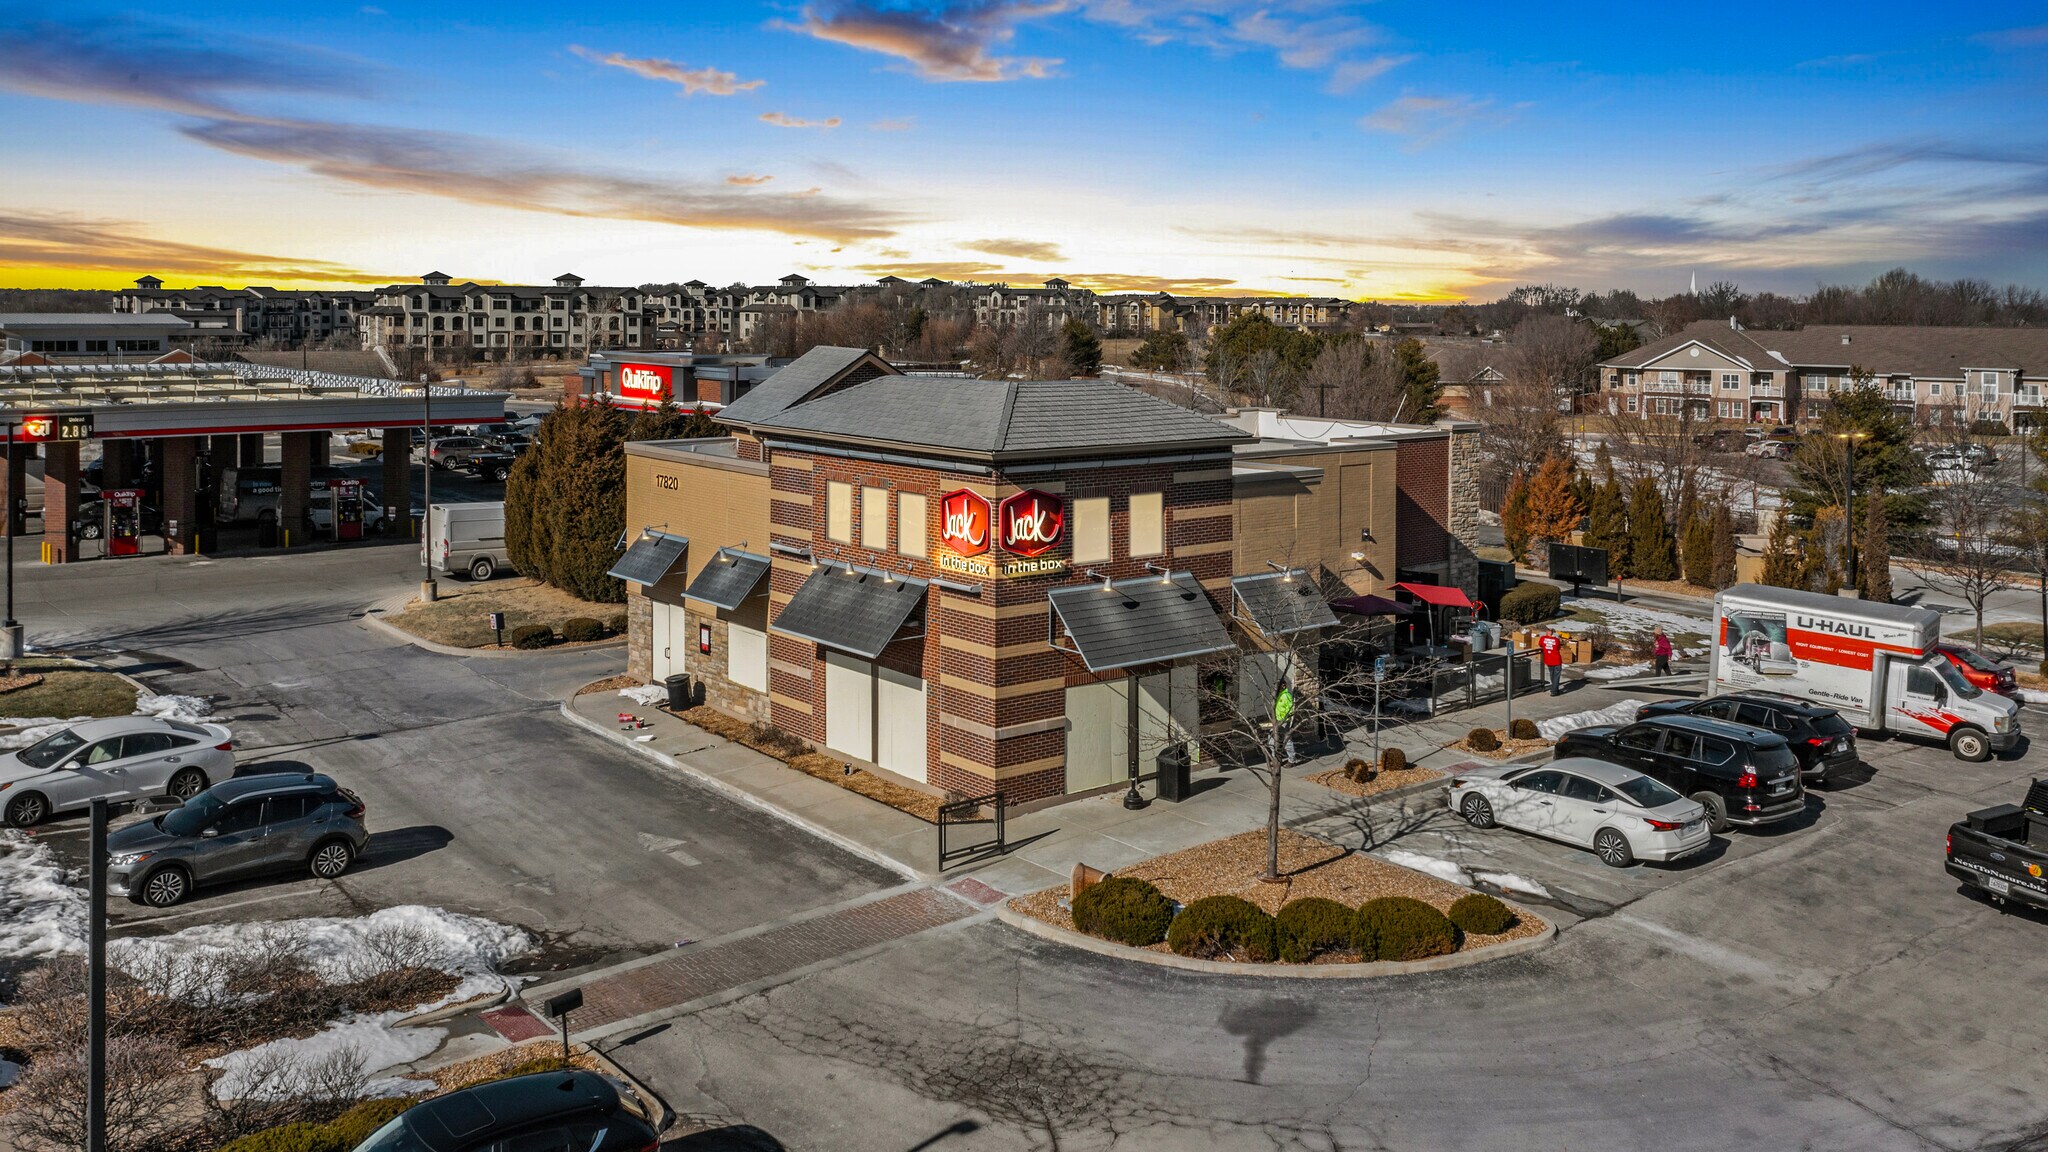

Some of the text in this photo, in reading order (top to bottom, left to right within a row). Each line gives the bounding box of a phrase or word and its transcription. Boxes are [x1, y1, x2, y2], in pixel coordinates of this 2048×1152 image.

[622, 367, 663, 395] QuikTrip
[27, 419, 53, 437] QT
[258, 486, 273, 494] good
[656, 474, 679, 491] 17820
[942, 499, 985, 546] Jack
[1006, 499, 1060, 546] Jack
[942, 554, 987, 575] in the box
[1004, 559, 1062, 575] in the box
[1797, 616, 1876, 639] U-HAUL
[1809, 643, 1834, 652] EQUIPMENT
[1953, 857, 2047, 893] NextToNature.biz
